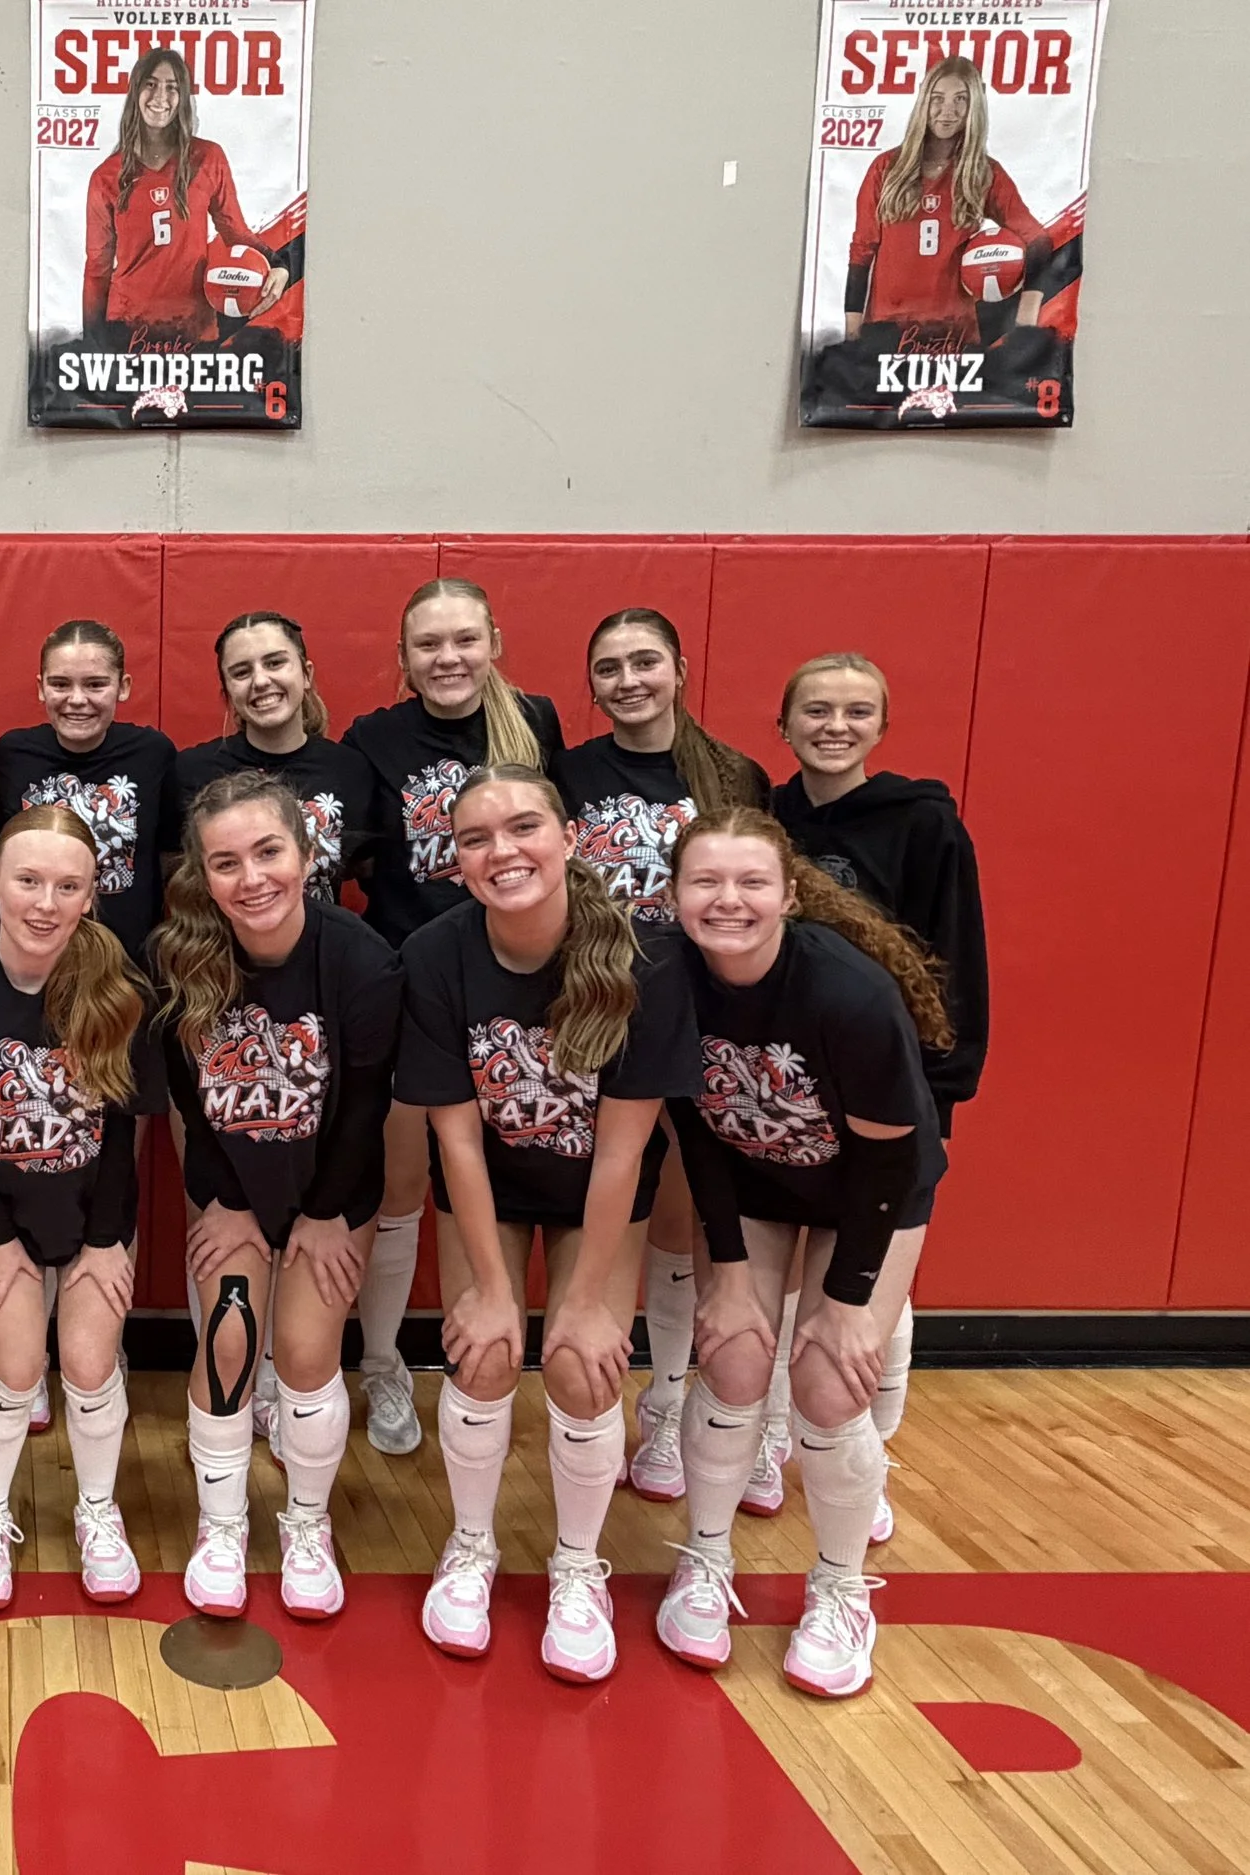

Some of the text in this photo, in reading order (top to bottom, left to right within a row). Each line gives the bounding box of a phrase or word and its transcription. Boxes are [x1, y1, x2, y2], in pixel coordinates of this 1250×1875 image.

[114, 11, 232, 25] VOLLEYBALL
[905, 12, 1023, 25] VOLLEYBALL
[37, 106, 100, 118] CLASS OF
[822, 107, 886, 119] CLASS OF
[37, 117, 100, 147] 2027
[821, 118, 885, 147] 2027
[151, 209, 172, 247] 6
[918, 218, 940, 257] 8
[124, 324, 197, 361] Brooke
[58, 352, 287, 420] SWEDBERG #6
[876, 353, 1062, 418] KUNZ #8
[204, 1083, 311, 1124] M.A.D.
